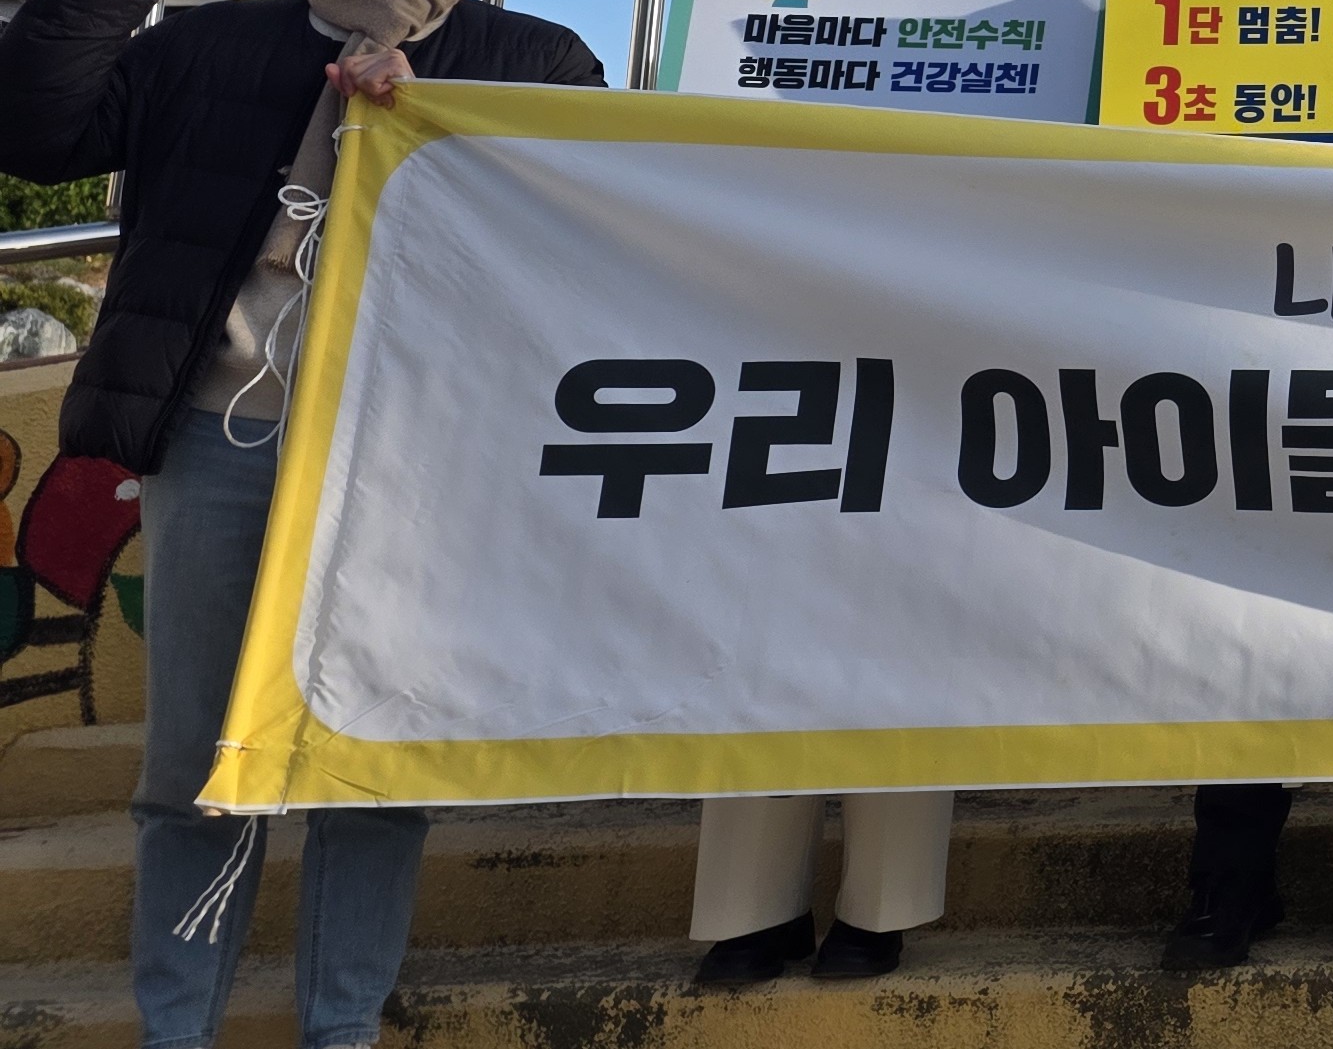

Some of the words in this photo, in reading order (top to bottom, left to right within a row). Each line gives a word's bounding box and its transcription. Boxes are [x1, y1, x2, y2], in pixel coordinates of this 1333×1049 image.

[743, 13, 887, 47] 마음마다
[897, 17, 1046, 50] 안전수칙!
[1237, 6, 1320, 45] 멈춤!
[737, 57, 880, 91] 행동마다
[890, 61, 1040, 94] 건강실천!
[1143, 66, 1217, 125] 3초
[1234, 83, 1317, 123] 동안!
[539, 356, 895, 519] 우리
